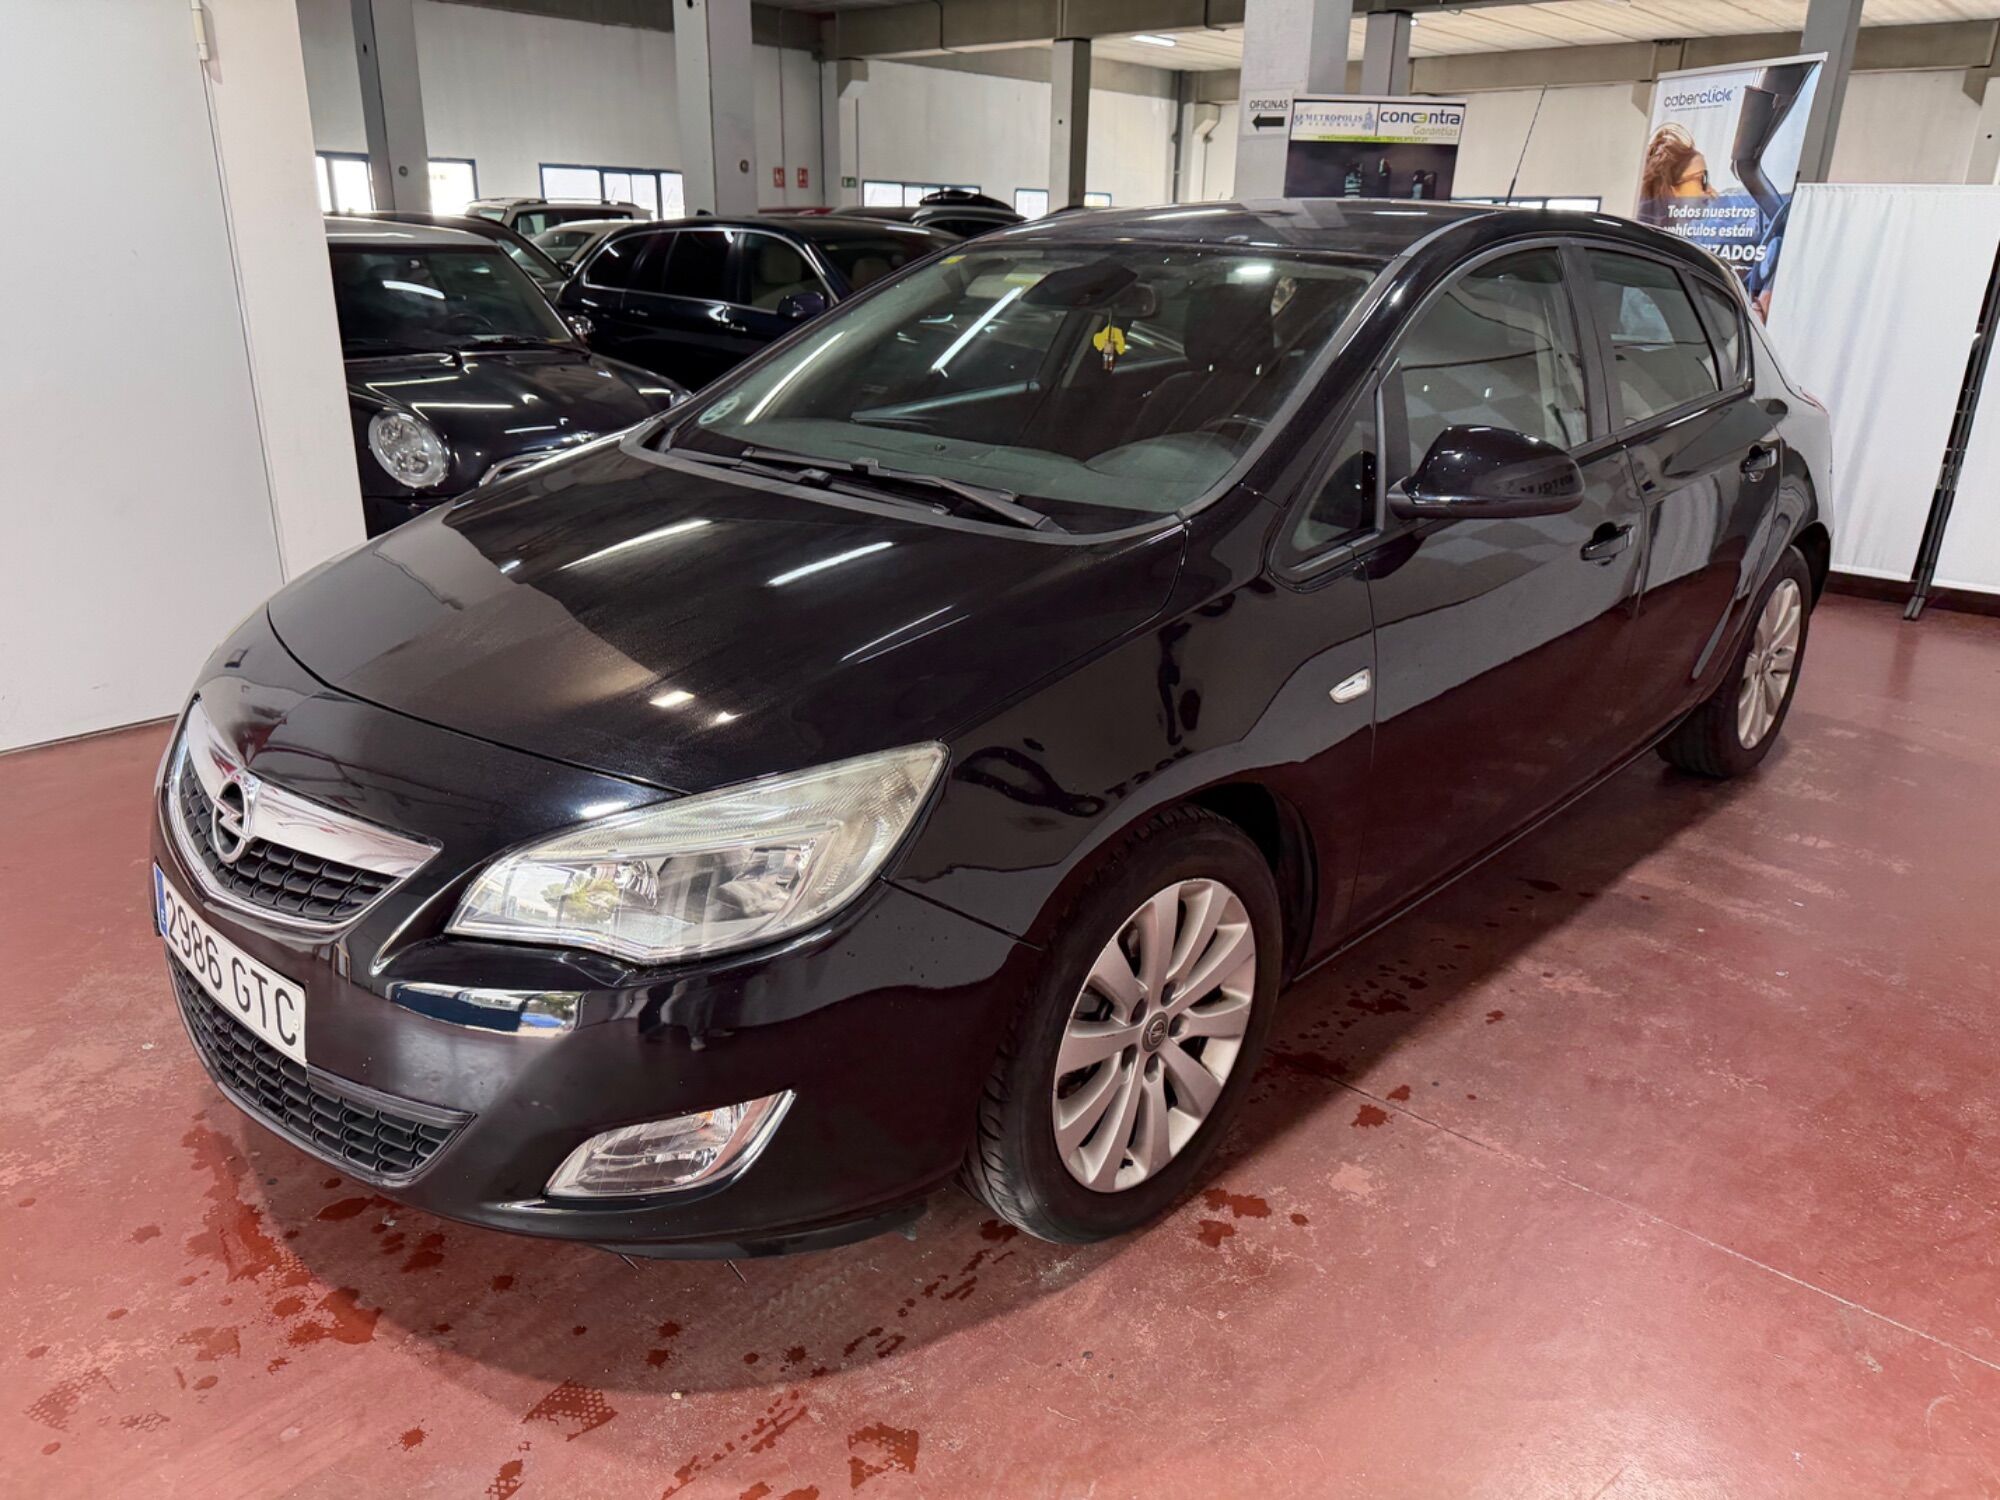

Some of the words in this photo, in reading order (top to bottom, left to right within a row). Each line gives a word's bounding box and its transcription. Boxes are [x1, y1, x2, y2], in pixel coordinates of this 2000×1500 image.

[1249, 99, 1289, 109] OFICINAS
[1305, 112, 1363, 123] METROPOLIS
[1380, 109, 1461, 125] concentra
[1667, 205, 1701, 218] Todos
[1702, 206, 1757, 218] nuestros
[1718, 225, 1753, 238] están
[166, 890, 223, 991] 2986
[231, 956, 297, 1047] GTC
